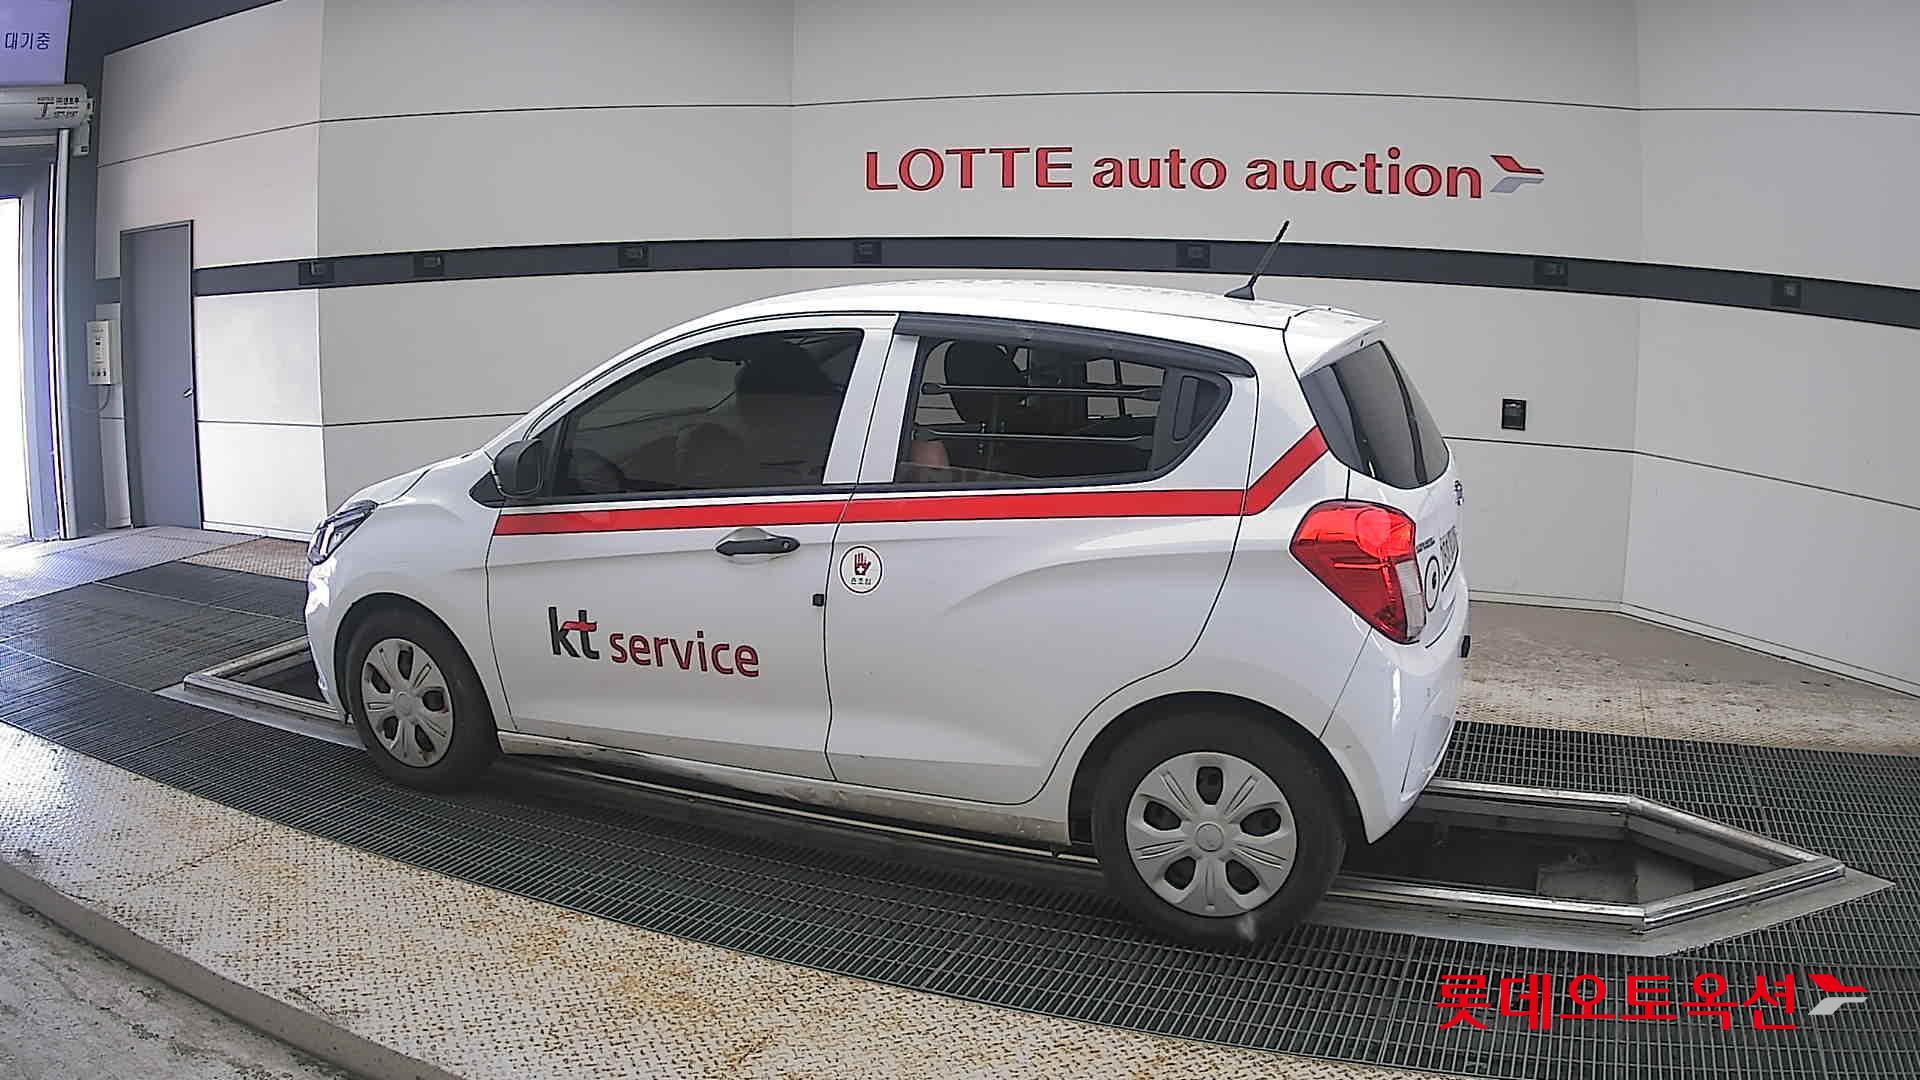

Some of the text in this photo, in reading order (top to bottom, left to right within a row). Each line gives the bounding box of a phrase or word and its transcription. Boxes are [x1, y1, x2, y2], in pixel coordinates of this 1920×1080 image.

[5, 32, 51, 50] 대기중
[865, 146, 1482, 198] LOTTE auto auction
[548, 606, 760, 677] kt service
